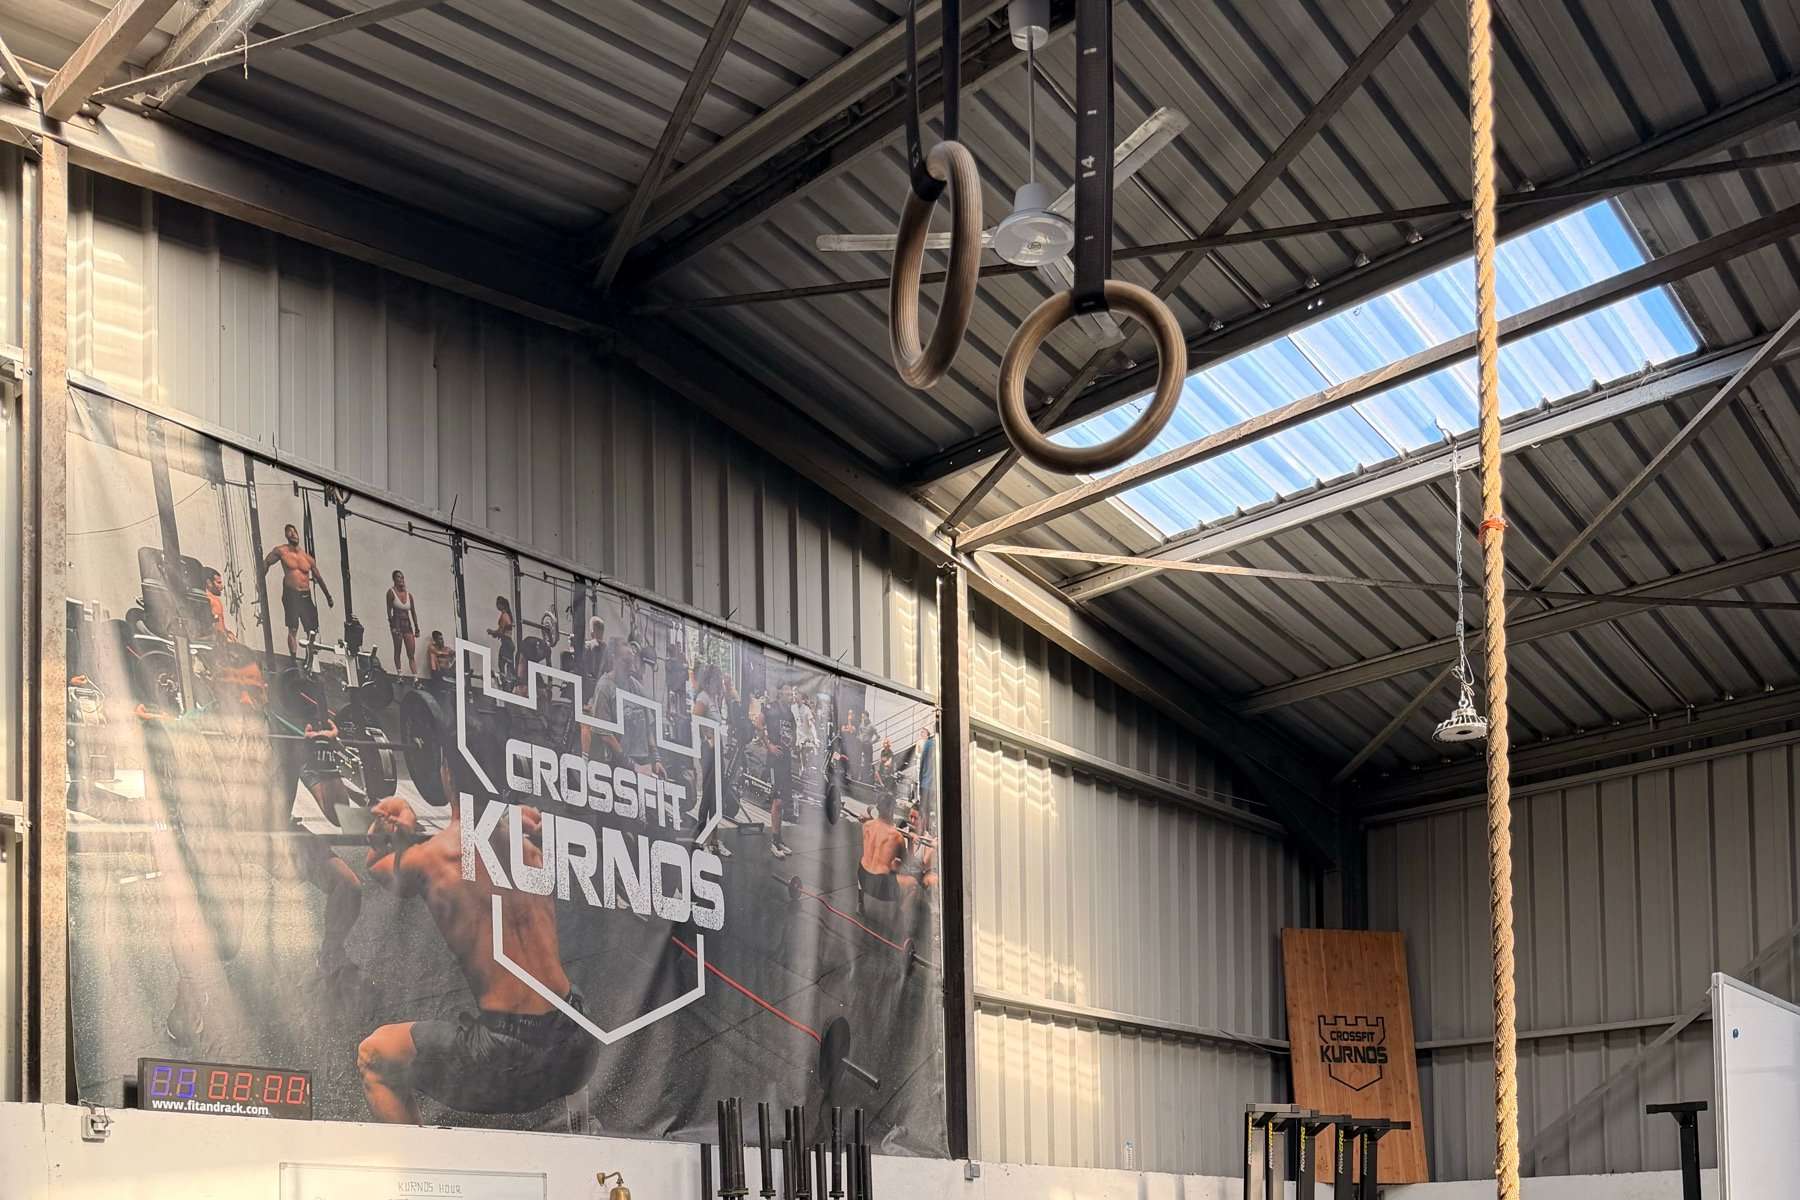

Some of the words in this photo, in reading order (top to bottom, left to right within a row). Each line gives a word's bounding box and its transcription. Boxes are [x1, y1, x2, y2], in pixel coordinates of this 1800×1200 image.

[505, 738, 687, 831] CROSSFIT
[459, 792, 725, 932] KURNOS
[1330, 1030, 1375, 1042] CROSSFIT
[1320, 1045, 1388, 1064] KURNOS
[151, 1099, 270, 1116] www.fitandrack.com
